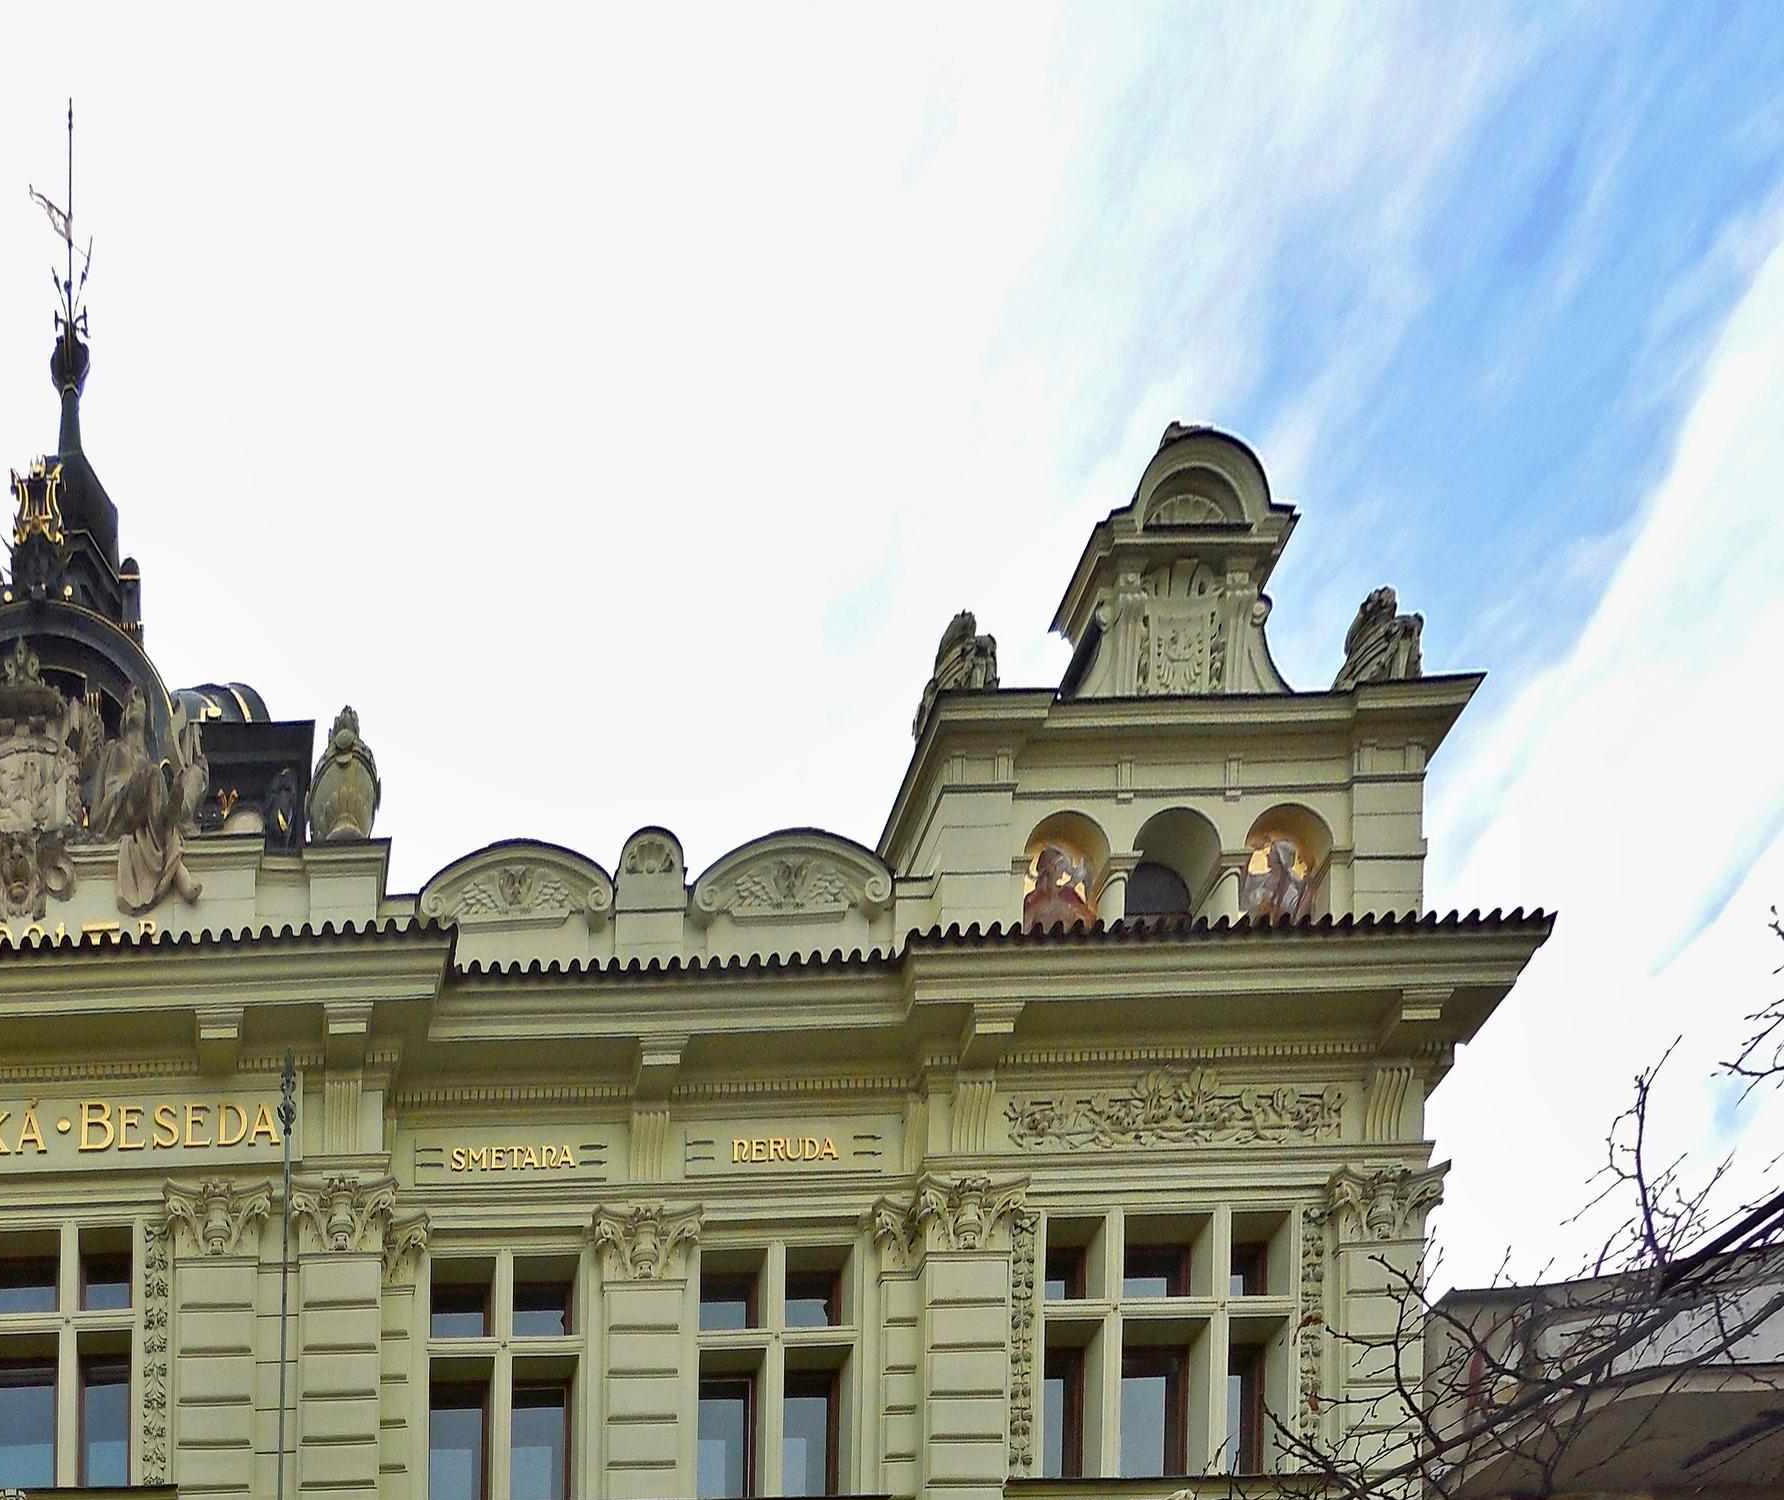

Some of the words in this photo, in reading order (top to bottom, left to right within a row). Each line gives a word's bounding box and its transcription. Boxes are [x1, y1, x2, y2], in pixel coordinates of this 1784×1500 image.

[78, 1100, 282, 1153] BESEDA
[451, 1144, 576, 1171] SMETANA
[732, 1137, 839, 1163] NERUDA
